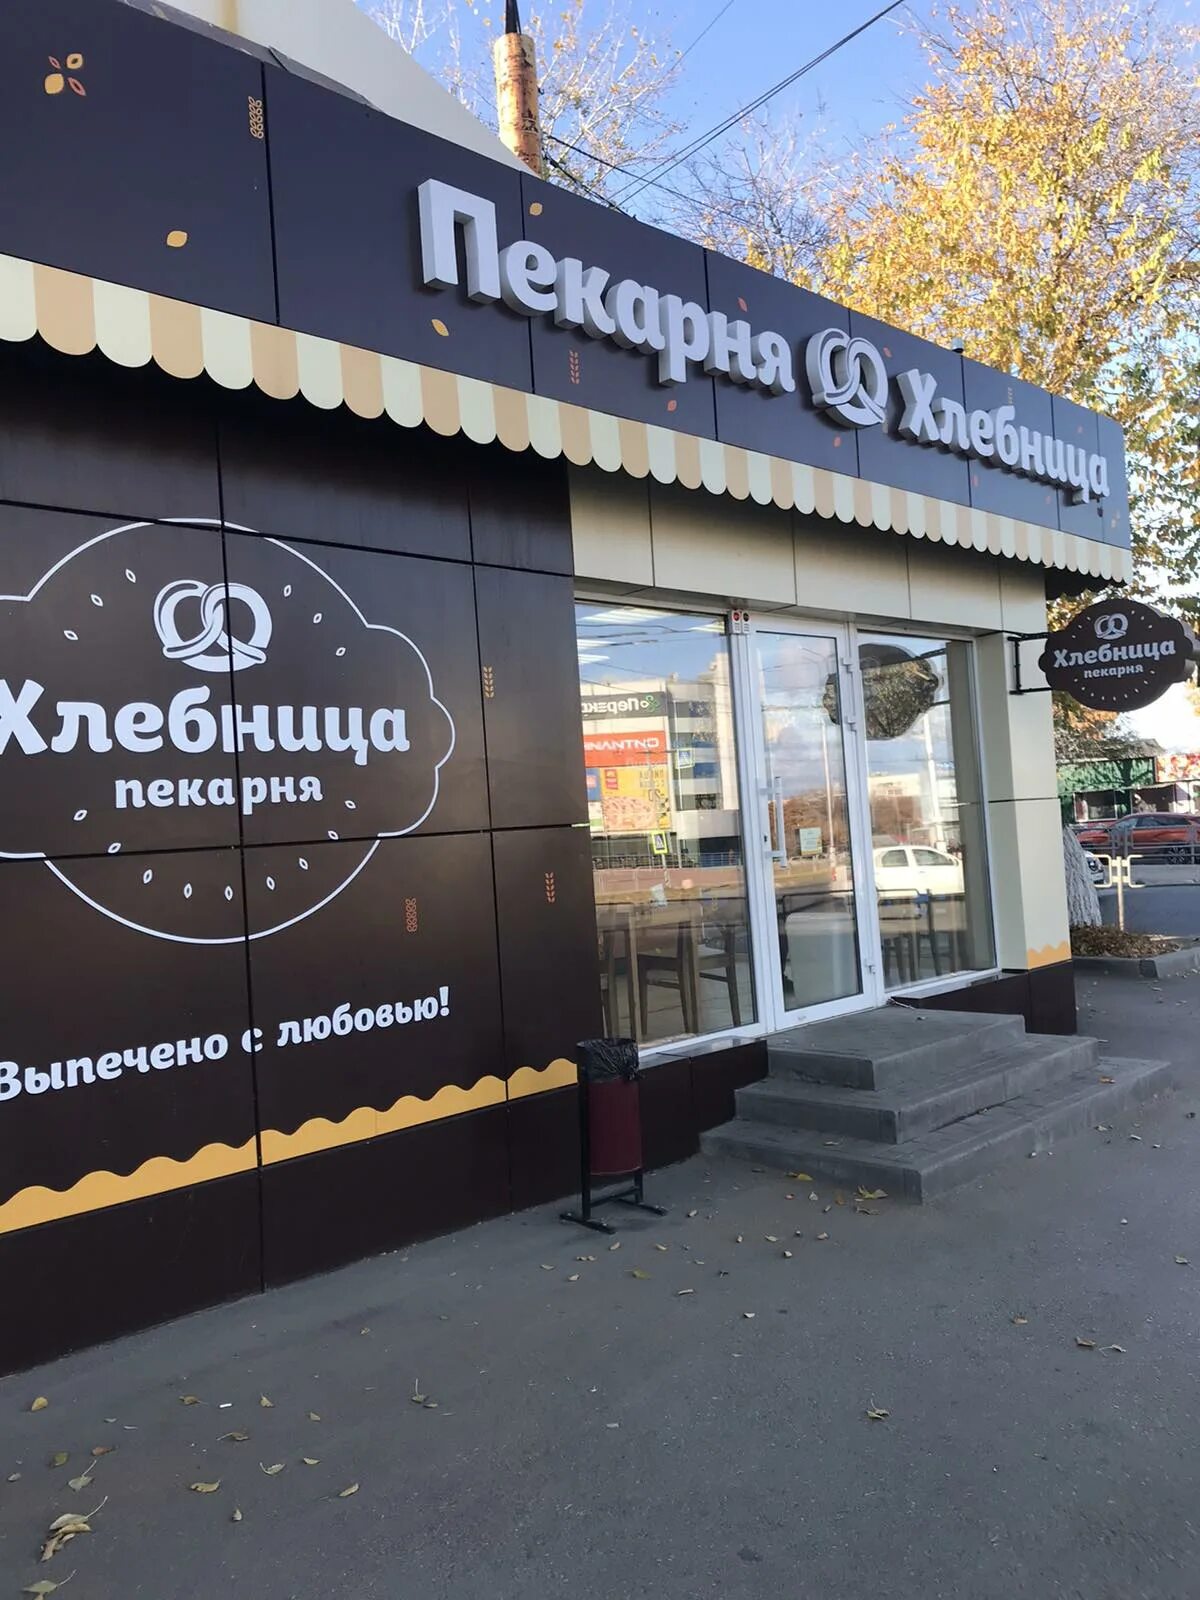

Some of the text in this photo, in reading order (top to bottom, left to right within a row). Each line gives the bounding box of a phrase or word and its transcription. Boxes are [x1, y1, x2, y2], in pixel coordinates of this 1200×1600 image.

[417, 178, 1110, 504] Пекарня Хлебница
[1054, 640, 1176, 668] Хлебница
[1084, 664, 1144, 679] пекарня
[0, 678, 410, 766] Хлебница
[115, 776, 323, 815] пекарня
[0, 986, 450, 1101] Выпечено с любовью!
